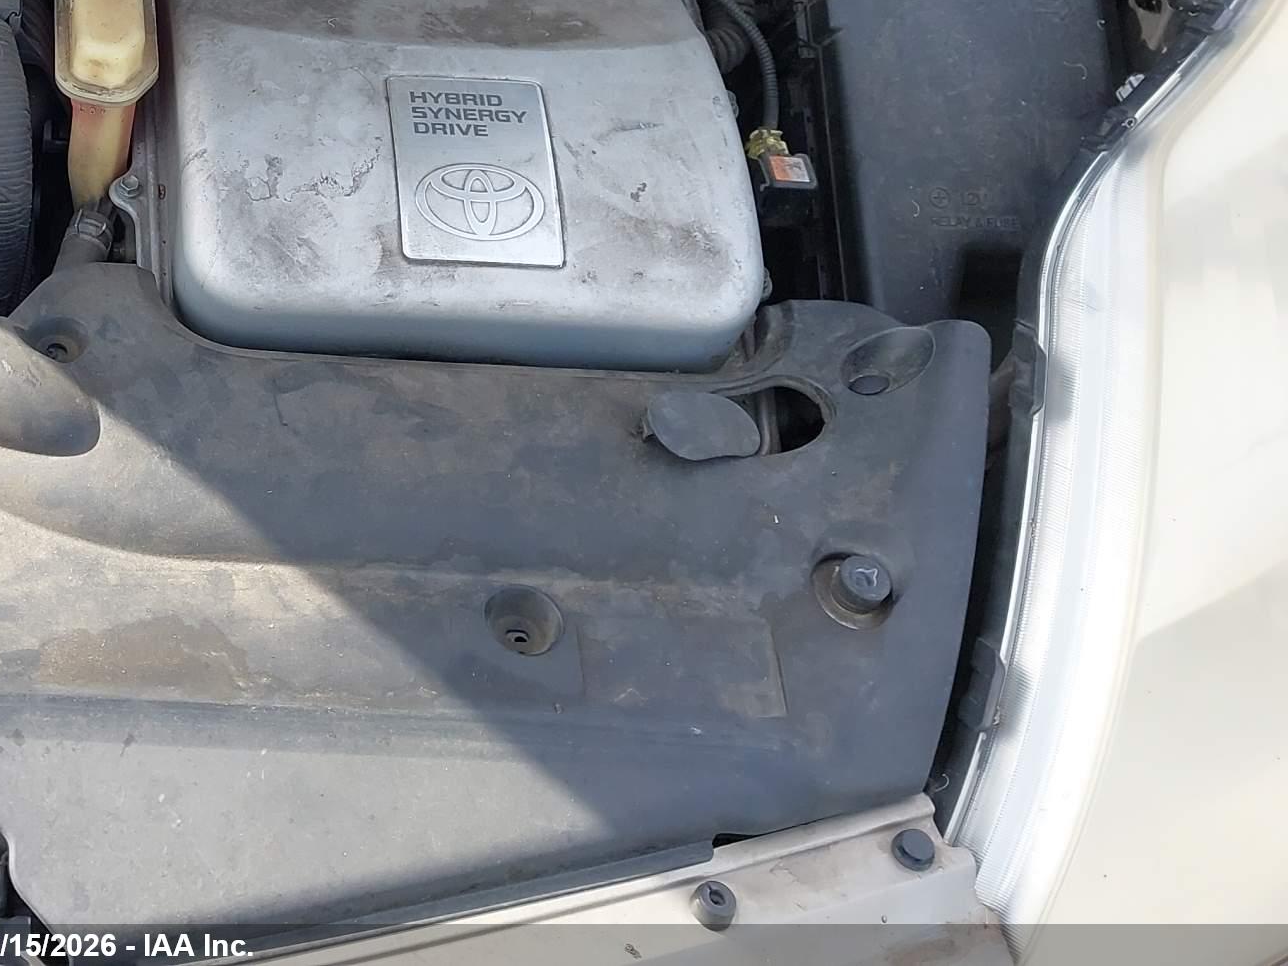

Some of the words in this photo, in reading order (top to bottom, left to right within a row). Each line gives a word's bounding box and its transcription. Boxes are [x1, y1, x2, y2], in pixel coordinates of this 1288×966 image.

[409, 91, 503, 106] HYBRID
[411, 106, 527, 123] SYNERGY
[413, 121, 489, 136] DRIVE
